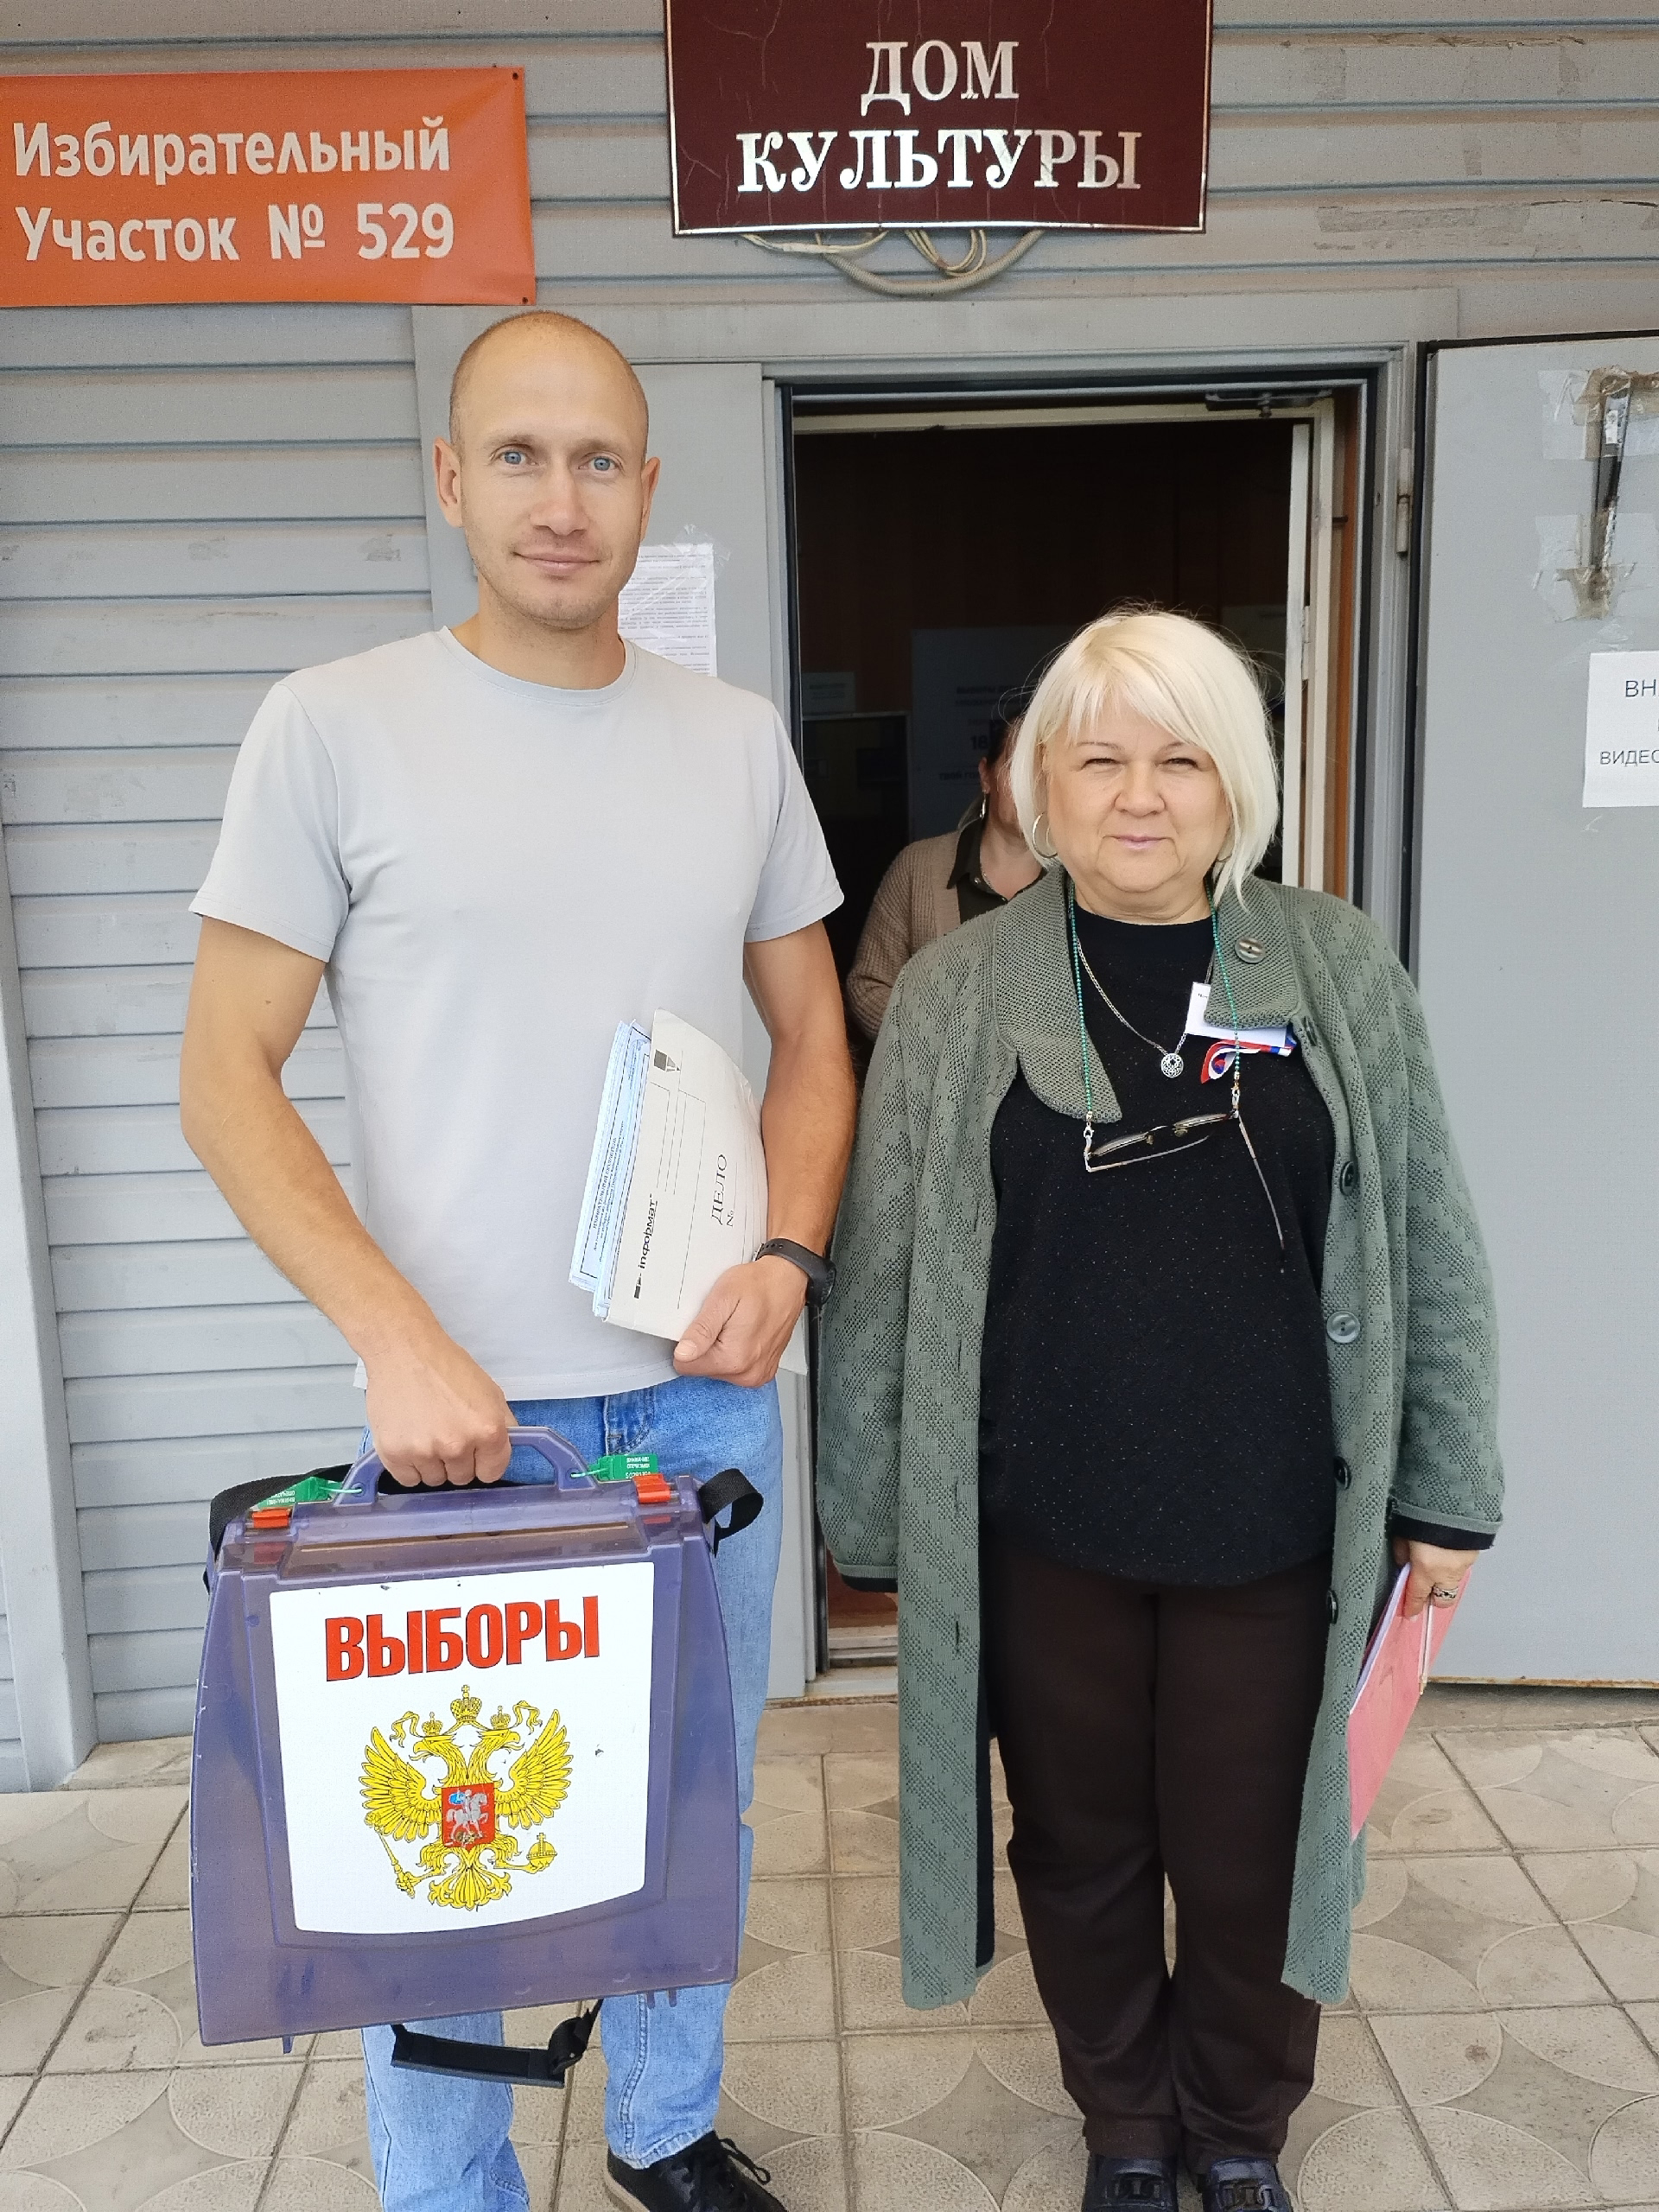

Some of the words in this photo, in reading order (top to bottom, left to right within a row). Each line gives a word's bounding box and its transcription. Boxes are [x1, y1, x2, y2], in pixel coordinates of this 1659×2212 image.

[861, 40, 1020, 117] ДОМ
[13, 115, 450, 186] Избирательный
[735, 128, 1142, 193] КУЛЬТУРЫ
[15, 206, 240, 261] Участок
[267, 203, 326, 260] №
[357, 202, 454, 260] 529
[1624, 678, 1659, 697] ВН
[711, 1154, 728, 1226] ДЕЛО
[726, 1210, 734, 1227] №
[325, 1595, 601, 1682] ВЫБОРЫ
